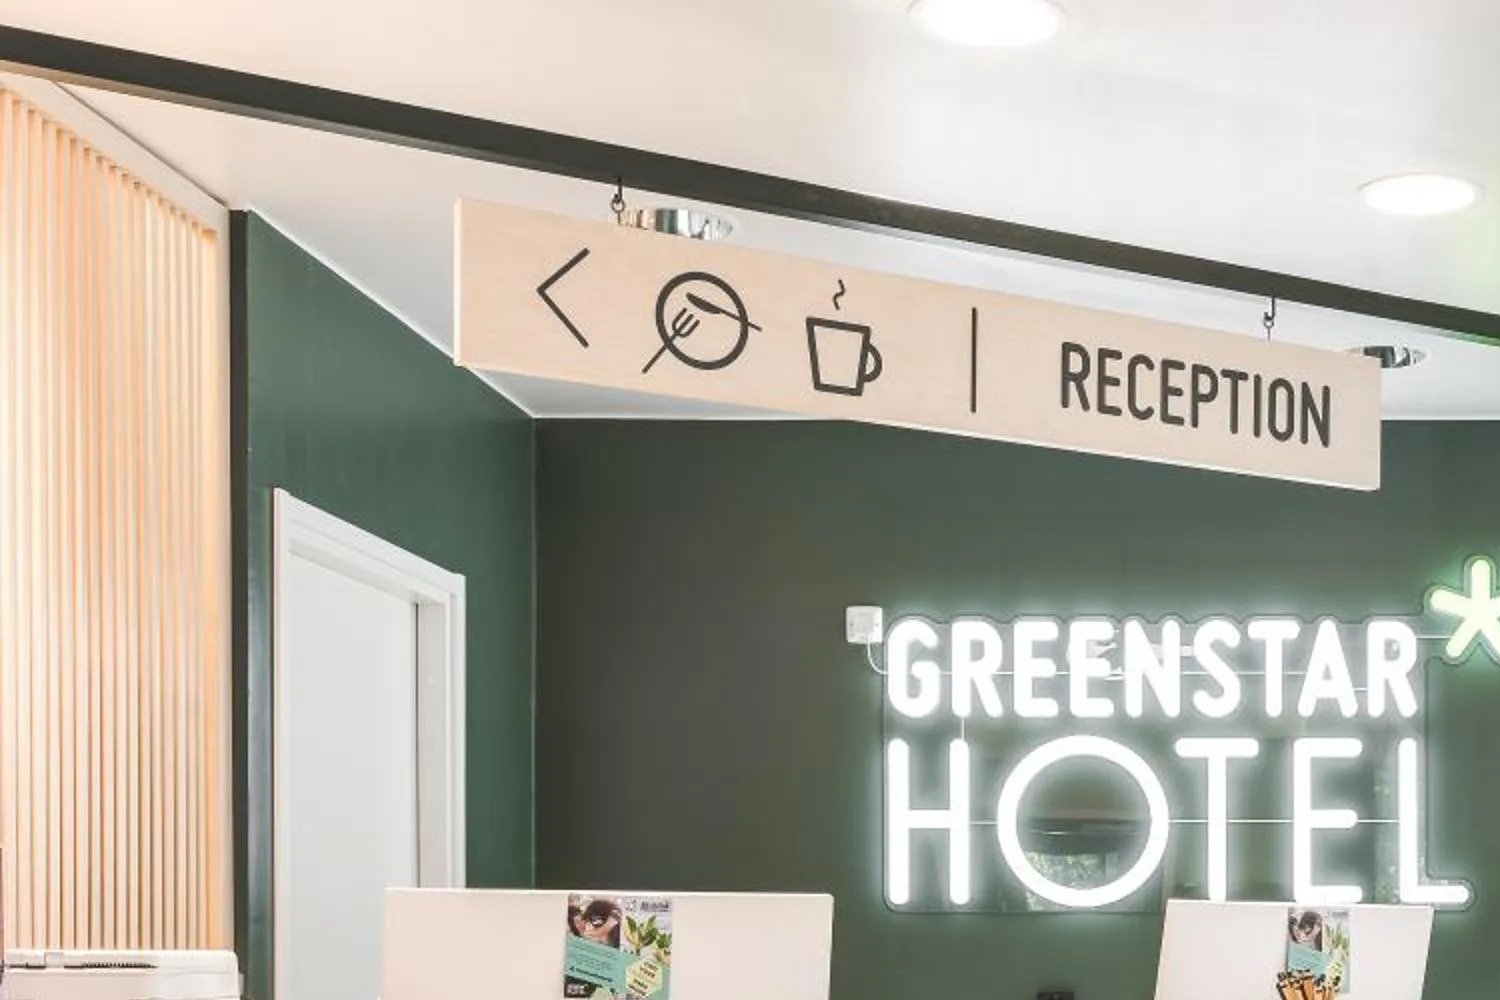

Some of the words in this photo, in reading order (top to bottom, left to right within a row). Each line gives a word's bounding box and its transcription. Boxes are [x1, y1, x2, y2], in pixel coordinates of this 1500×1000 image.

[1059, 340, 1332, 449] RECEPTION
[886, 617, 1419, 720] GREENSTAR
[886, 733, 1472, 907] HOTEL
